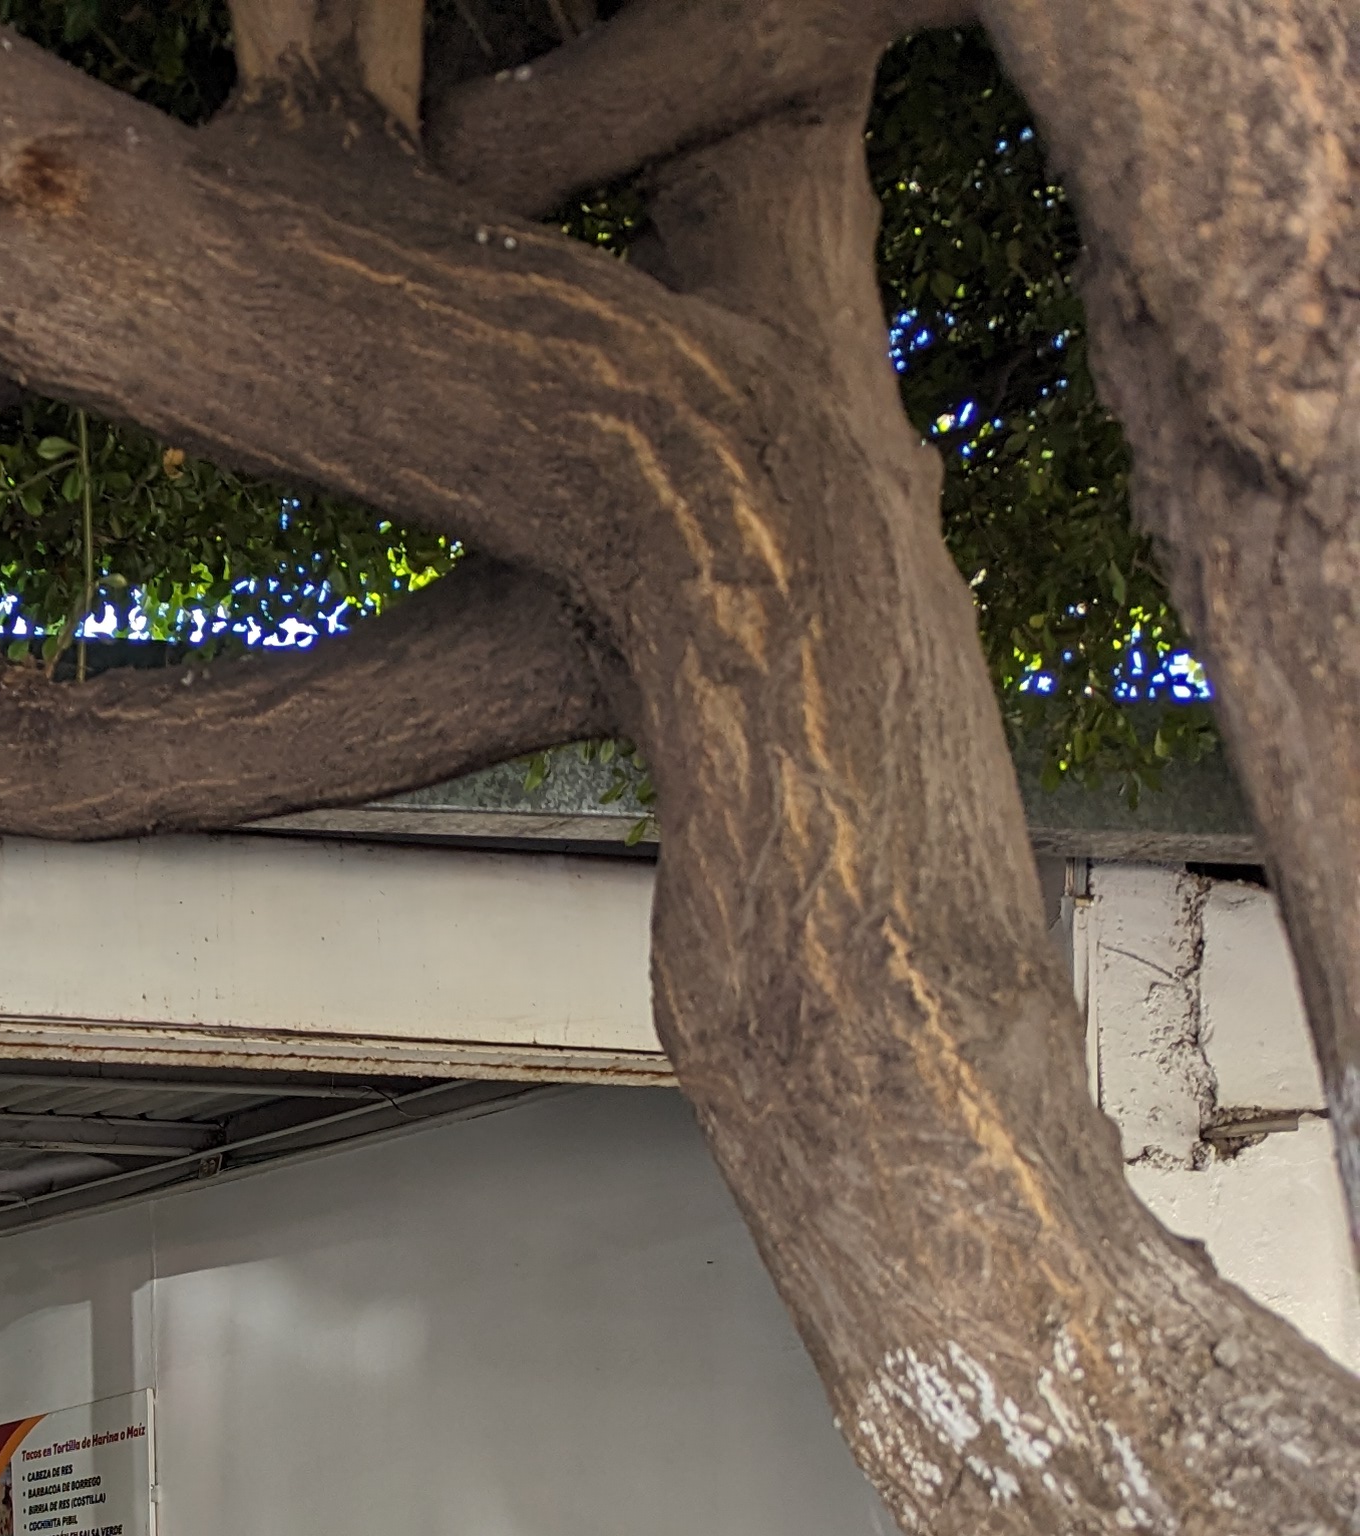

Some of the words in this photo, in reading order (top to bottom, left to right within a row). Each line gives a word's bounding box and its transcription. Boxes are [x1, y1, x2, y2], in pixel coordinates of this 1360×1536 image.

[22, 1450, 41, 1462] Tacos
[43, 1448, 52, 1457] en
[53, 1439, 80, 1455] Tortilla
[81, 1437, 91, 1449] de
[92, 1431, 119, 1447] Harina
[120, 1431, 125, 1440] o
[127, 1422, 146, 1439] Maíz
[27, 1469, 51, 1482] CABEZA
[52, 1467, 60, 1477] DE
[61, 1464, 73, 1475] RES
[28, 1484, 61, 1499] BARBACOA
[62, 1482, 70, 1492] DE
[71, 1476, 101, 1491] BORREGO
[28, 1503, 48, 1515] BIRRIA
[50, 1501, 57, 1511] DE
[59, 1499, 70, 1510] RES
[71, 1493, 106, 1508] (COSTILLA)
[29, 1517, 61, 1531] COCHINITA
[101, 1524, 123, 1536] VERDE
